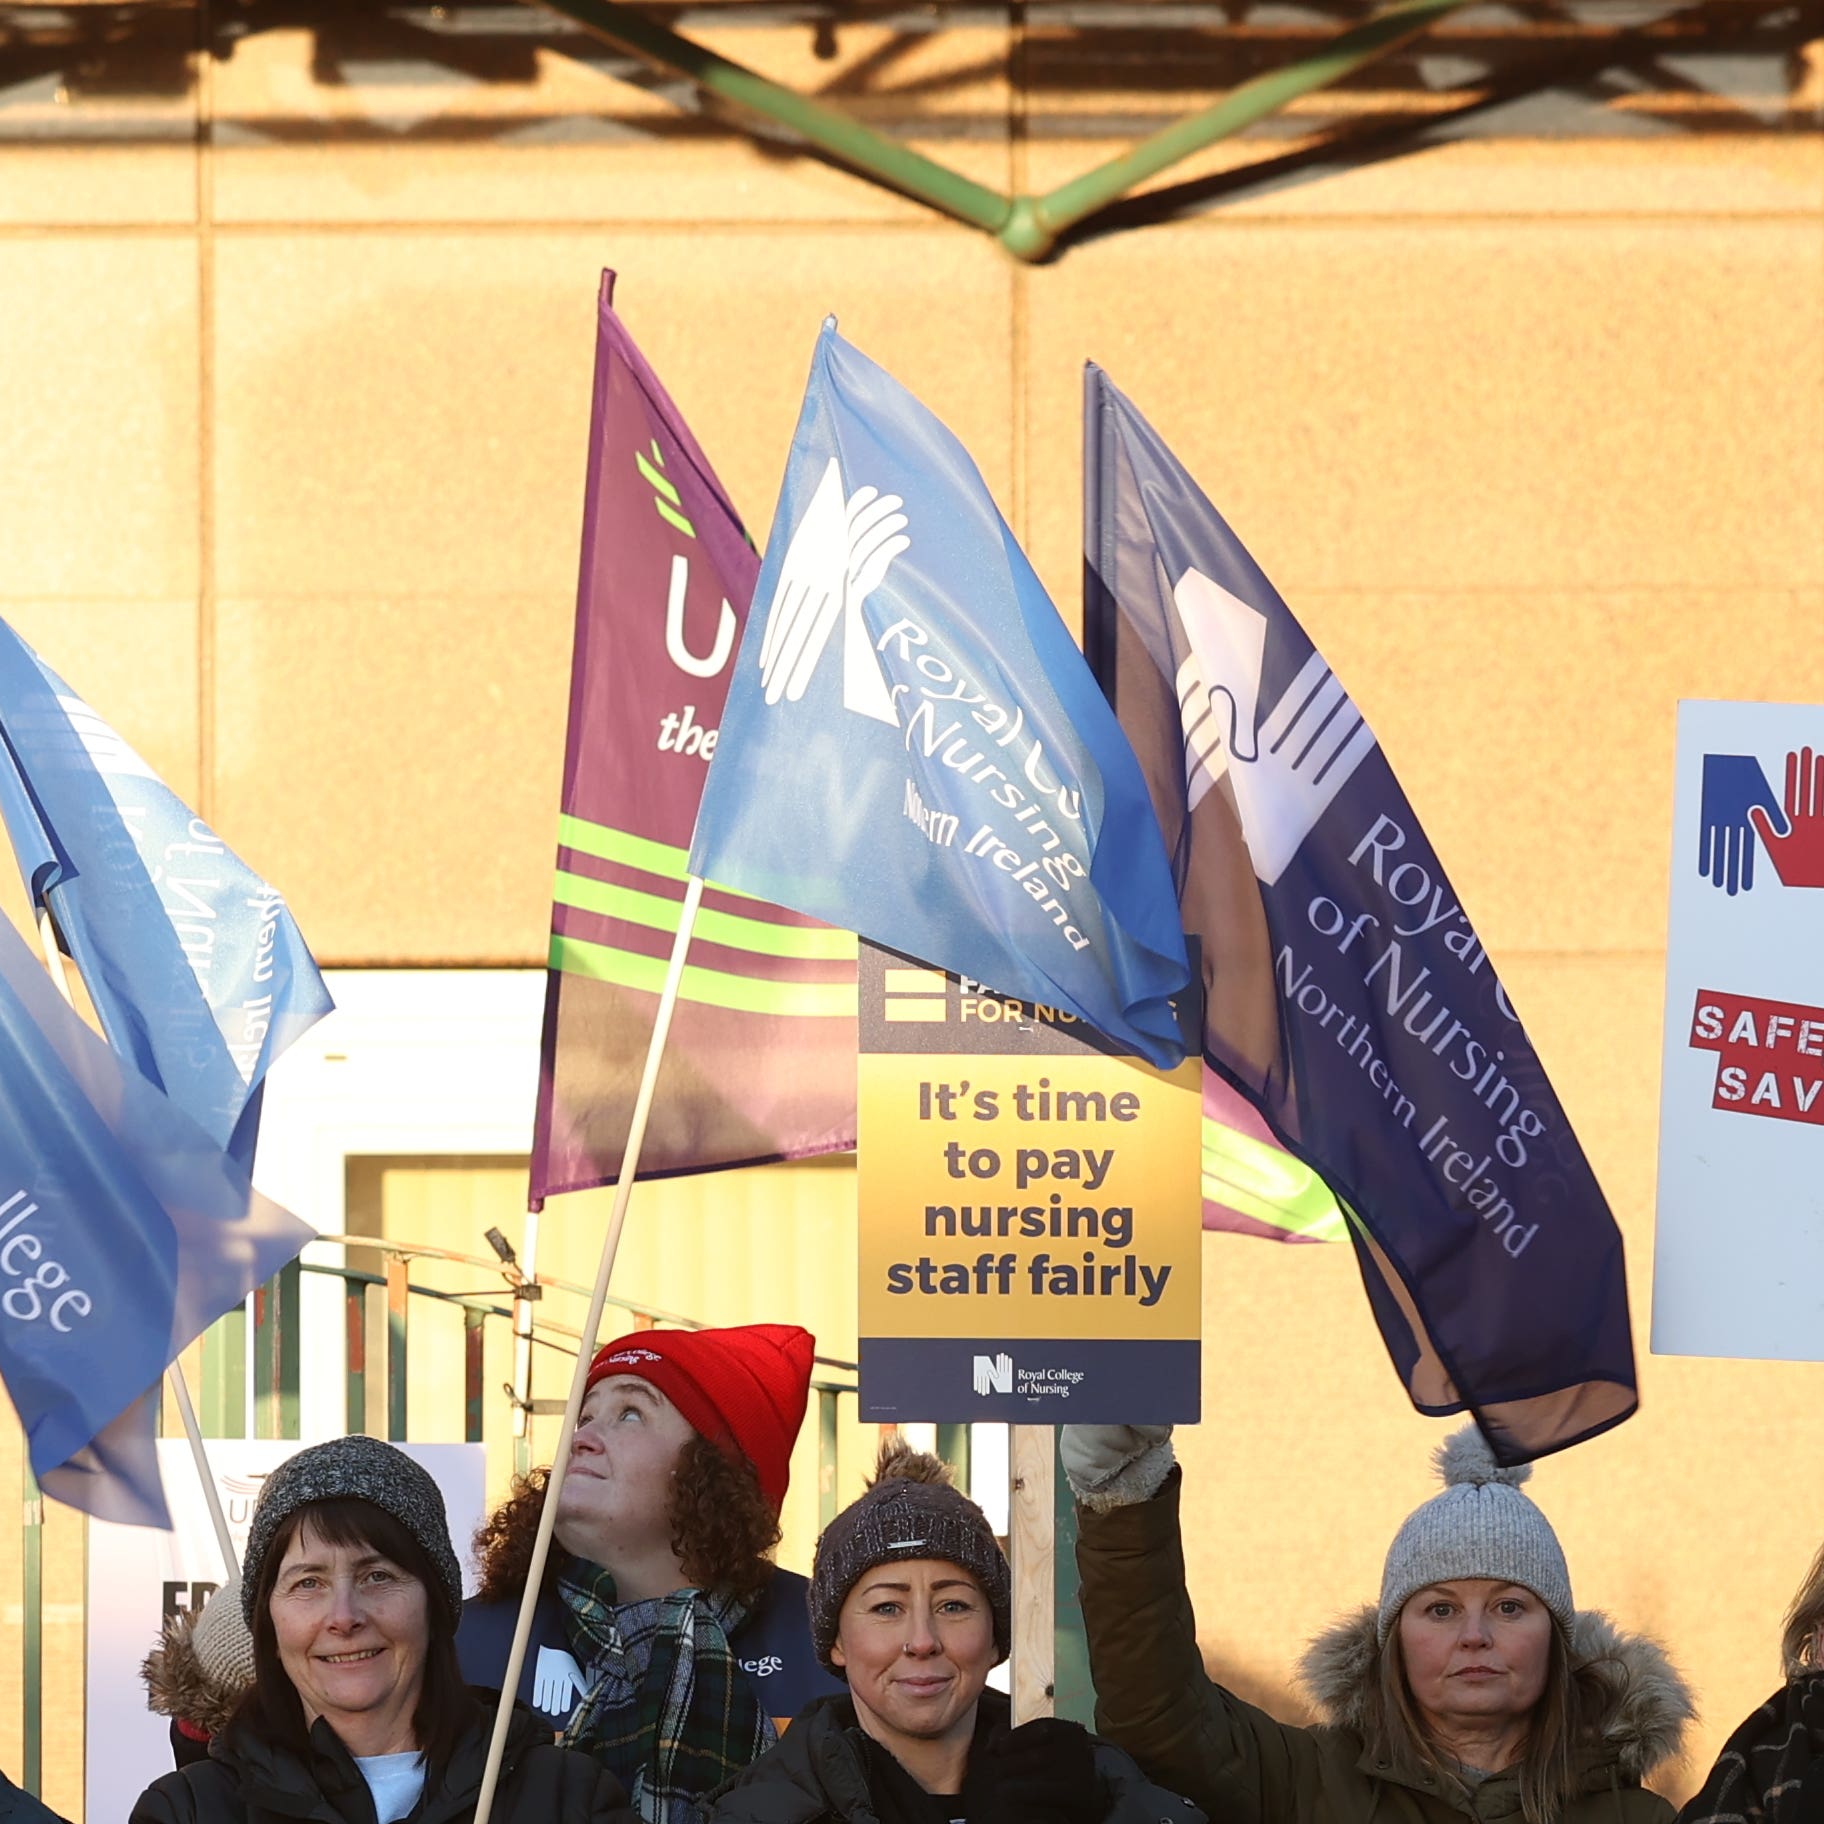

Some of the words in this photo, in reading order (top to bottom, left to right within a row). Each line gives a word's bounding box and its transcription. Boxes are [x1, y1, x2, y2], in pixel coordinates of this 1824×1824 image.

[876, 617, 1023, 747] Royal
[905, 700, 1087, 891] Nursing
[964, 824, 1090, 952] Ireland
[960, 999, 1023, 1022] FOR
[1307, 896, 1380, 954] of
[1363, 940, 1547, 1168] Nursing
[920, 1080, 999, 1121] It's
[1013, 1077, 1140, 1121] time
[1276, 944, 1417, 1128] Northern
[1418, 1115, 1539, 1259] Ireland
[945, 1142, 1001, 1180] to
[1016, 1146, 1115, 1190] pay
[925, 1193, 1134, 1248] nursing
[887, 1253, 1016, 1296] staff
[1028, 1251, 1172, 1306] fairly
[1017, 1383, 1029, 1394] of
[1031, 1382, 1069, 1398] Nursing
[1018, 1369, 1045, 1383] Royal
[1047, 1369, 1084, 1385] College
